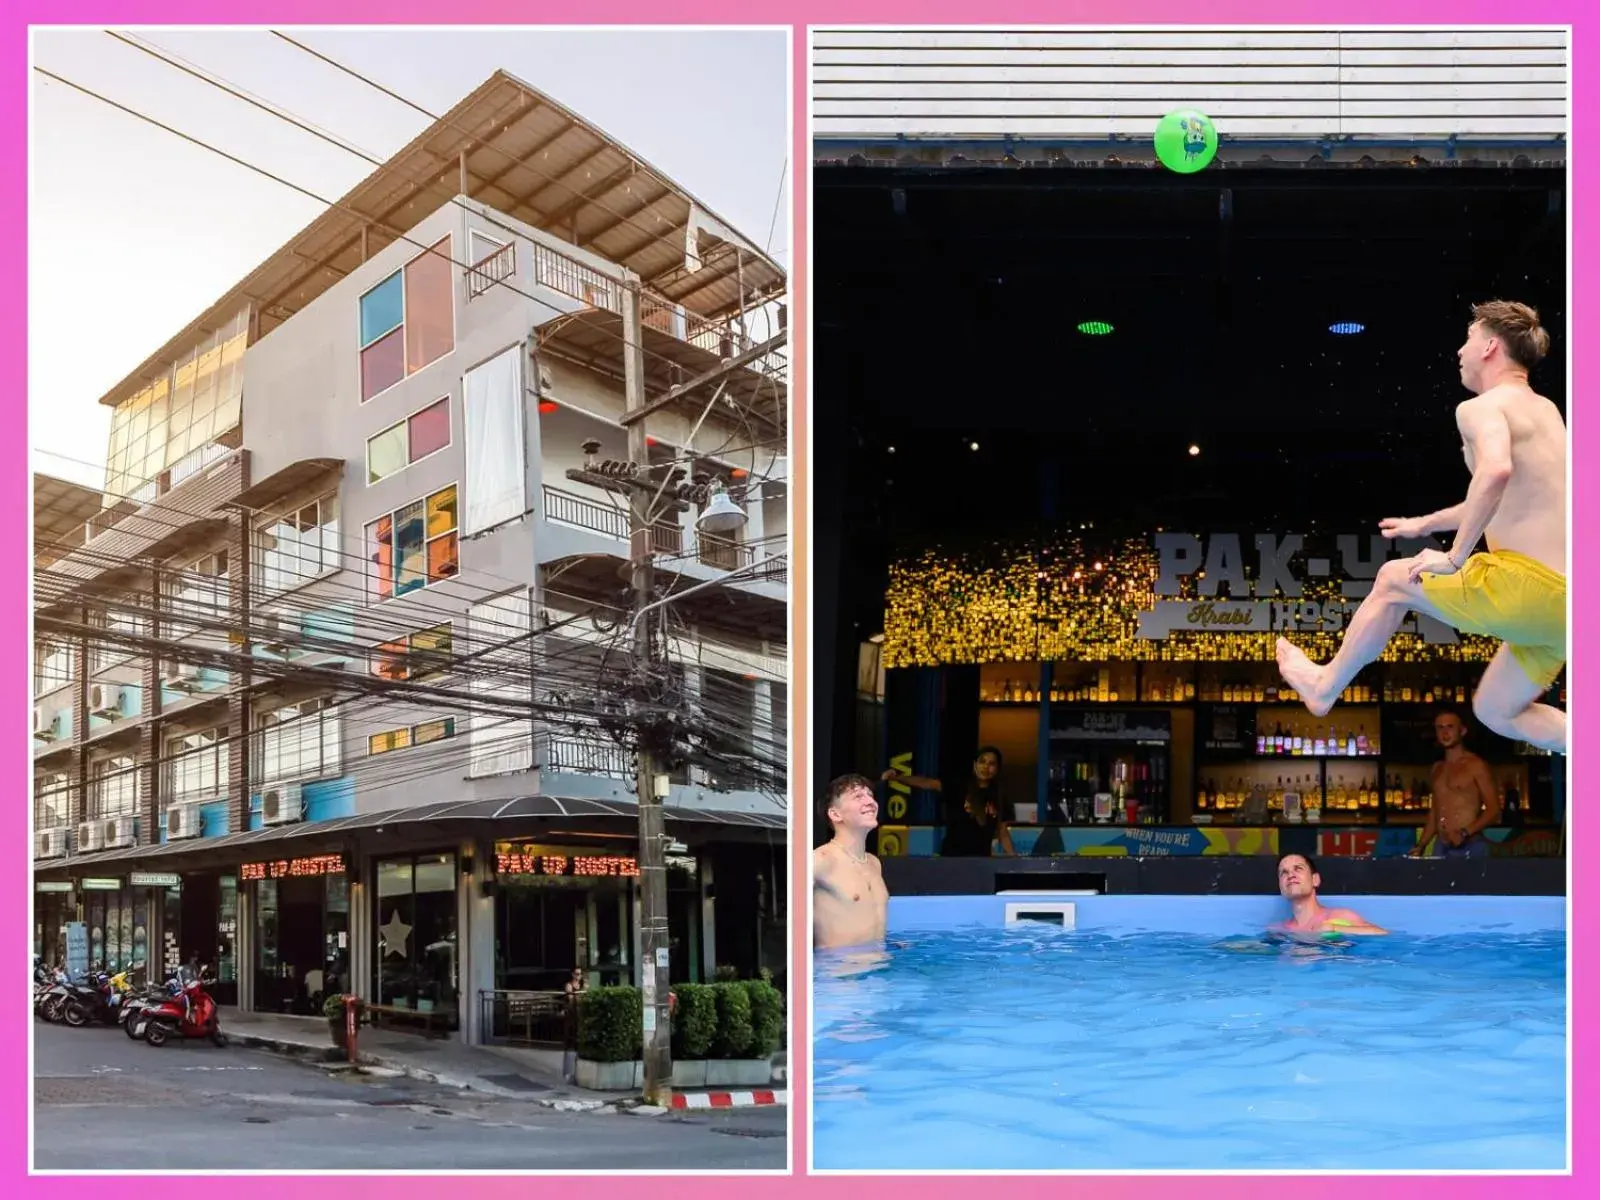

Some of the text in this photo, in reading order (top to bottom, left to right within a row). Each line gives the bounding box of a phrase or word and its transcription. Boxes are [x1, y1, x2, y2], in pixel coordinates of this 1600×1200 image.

[1186, 602, 1253, 627] Krabi
[241, 854, 345, 880] PAK UP HOSTEL
[497, 853, 640, 876] PAK UP HOSTEL
